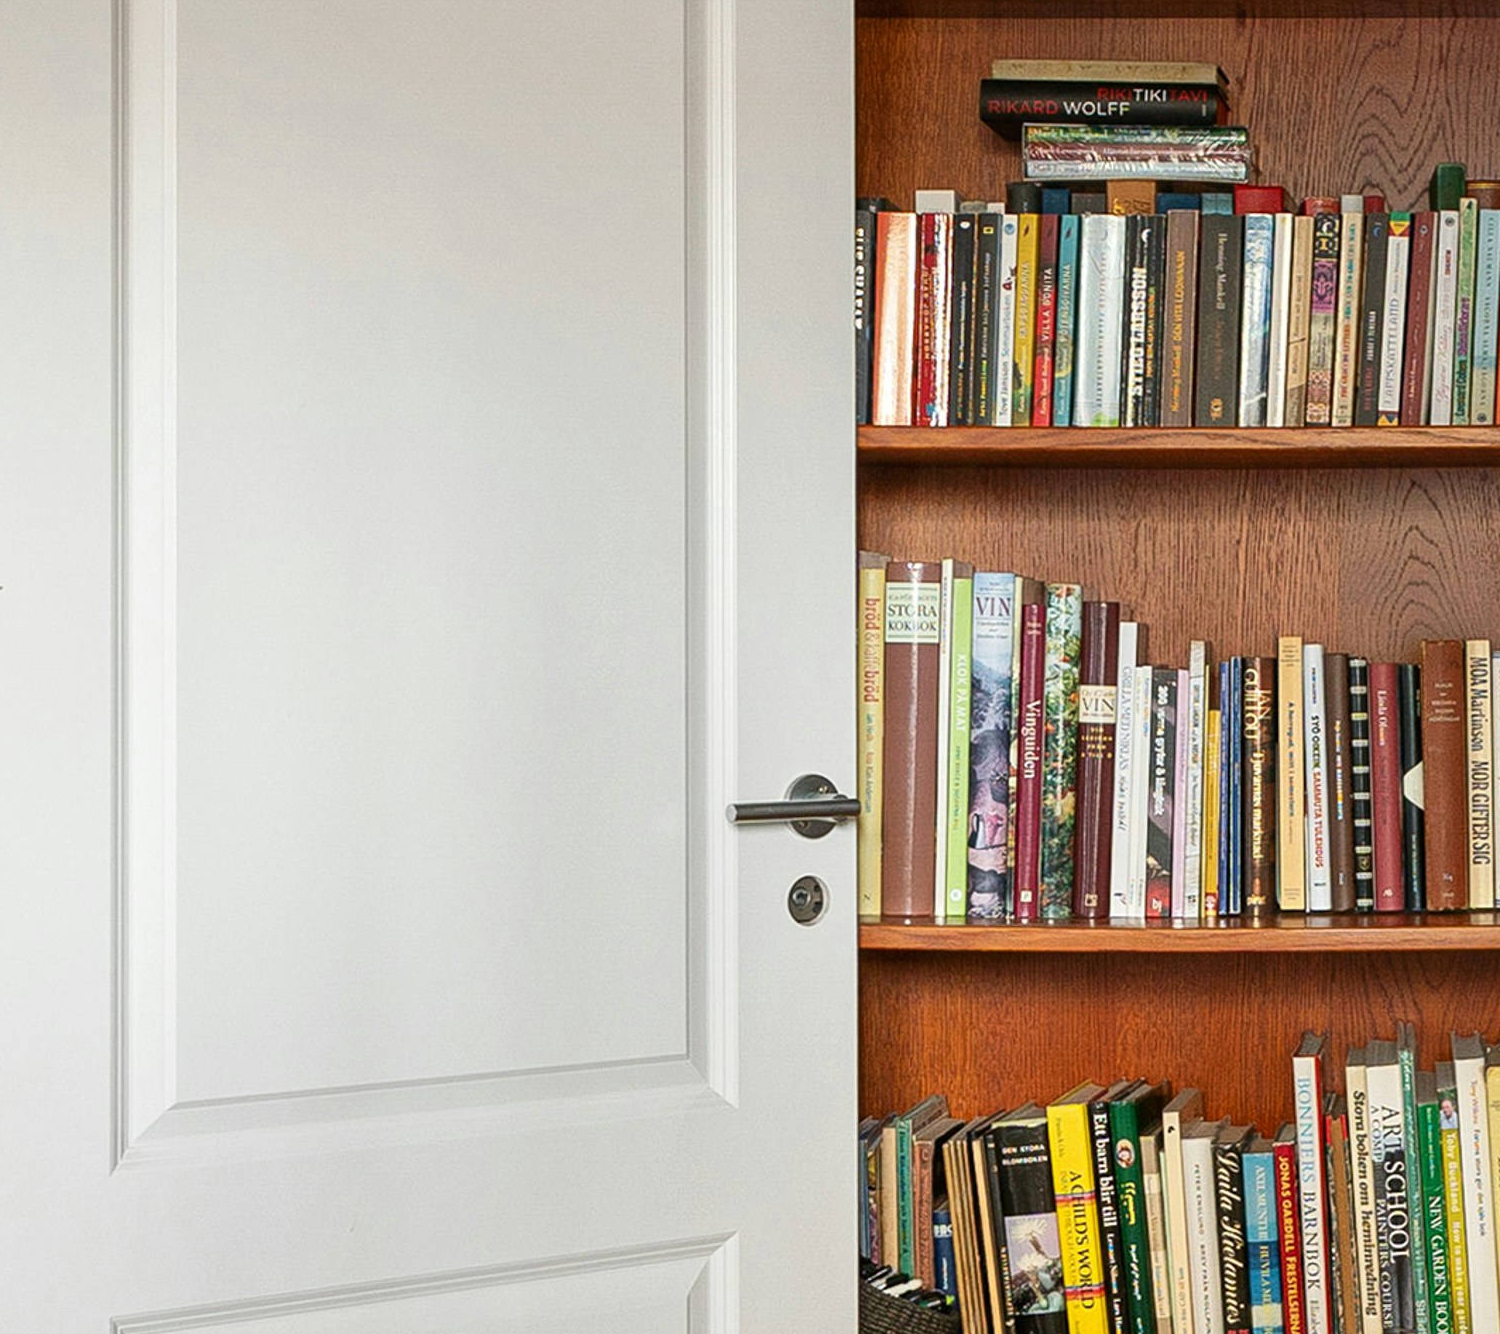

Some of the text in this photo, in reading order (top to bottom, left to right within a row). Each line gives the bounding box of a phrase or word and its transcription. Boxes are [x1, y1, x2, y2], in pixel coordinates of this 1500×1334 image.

[987, 100, 1131, 116] RIKARD WOLFF
[1215, 233, 1227, 309] Henning Mankell
[1042, 268, 1052, 341] VILLA BONITA
[1130, 267, 1146, 397] STIEG LARSSON
[1000, 295, 1011, 416] Tove Jansson Sommarboken
[865, 598, 880, 630] bröd
[974, 597, 1011, 616] VIN
[863, 643, 880, 703] kaffebröd
[1377, 690, 1387, 715] Linda
[1082, 698, 1115, 711] VIN
[1119, 667, 1132, 770] GRILLA MED NIKLAS
[1243, 668, 1258, 739] GUILLOU
[1258, 689, 1271, 720] JAN
[1311, 715, 1321, 734] SYÖ
[1022, 699, 1041, 779] Vinguiden
[1469, 657, 1490, 865] MOA Martinson MOR GIFTER SIG
[1251, 751, 1265, 859] Tjuvarnas marknad
[1312, 772, 1322, 818] SAMMUTA
[1314, 821, 1324, 867] TULEHDUS
[1093, 1114, 1117, 1227] Ett barn blir till
[1445, 1132, 1457, 1159] Toby
[1279, 1156, 1291, 1196] JONAS
[1296, 1077, 1321, 1290] BONNIERS BARNBOK
[1352, 1090, 1378, 1316] Stora boken om heminredning
[1381, 1105, 1409, 1264] ART SCHOOL
[1449, 1162, 1460, 1212] Buckland
[1069, 1171, 1095, 1310] A CHILD'S WORLD
[1196, 1195, 1204, 1235] ENGLUND
[1201, 1269, 1211, 1291] FRÅN
[1216, 1152, 1244, 1324] Laila Hietamies
[1282, 1200, 1295, 1253] GARDELL
[1428, 1195, 1443, 1232] NEW
[1451, 1222, 1461, 1242] How
[1376, 1199, 1394, 1329] PAINTERS COURSE
[1431, 1235, 1446, 1295] GARDEN
[1452, 1246, 1461, 1256] to
[1453, 1258, 1464, 1282] make
[1455, 1284, 1466, 1306] your
